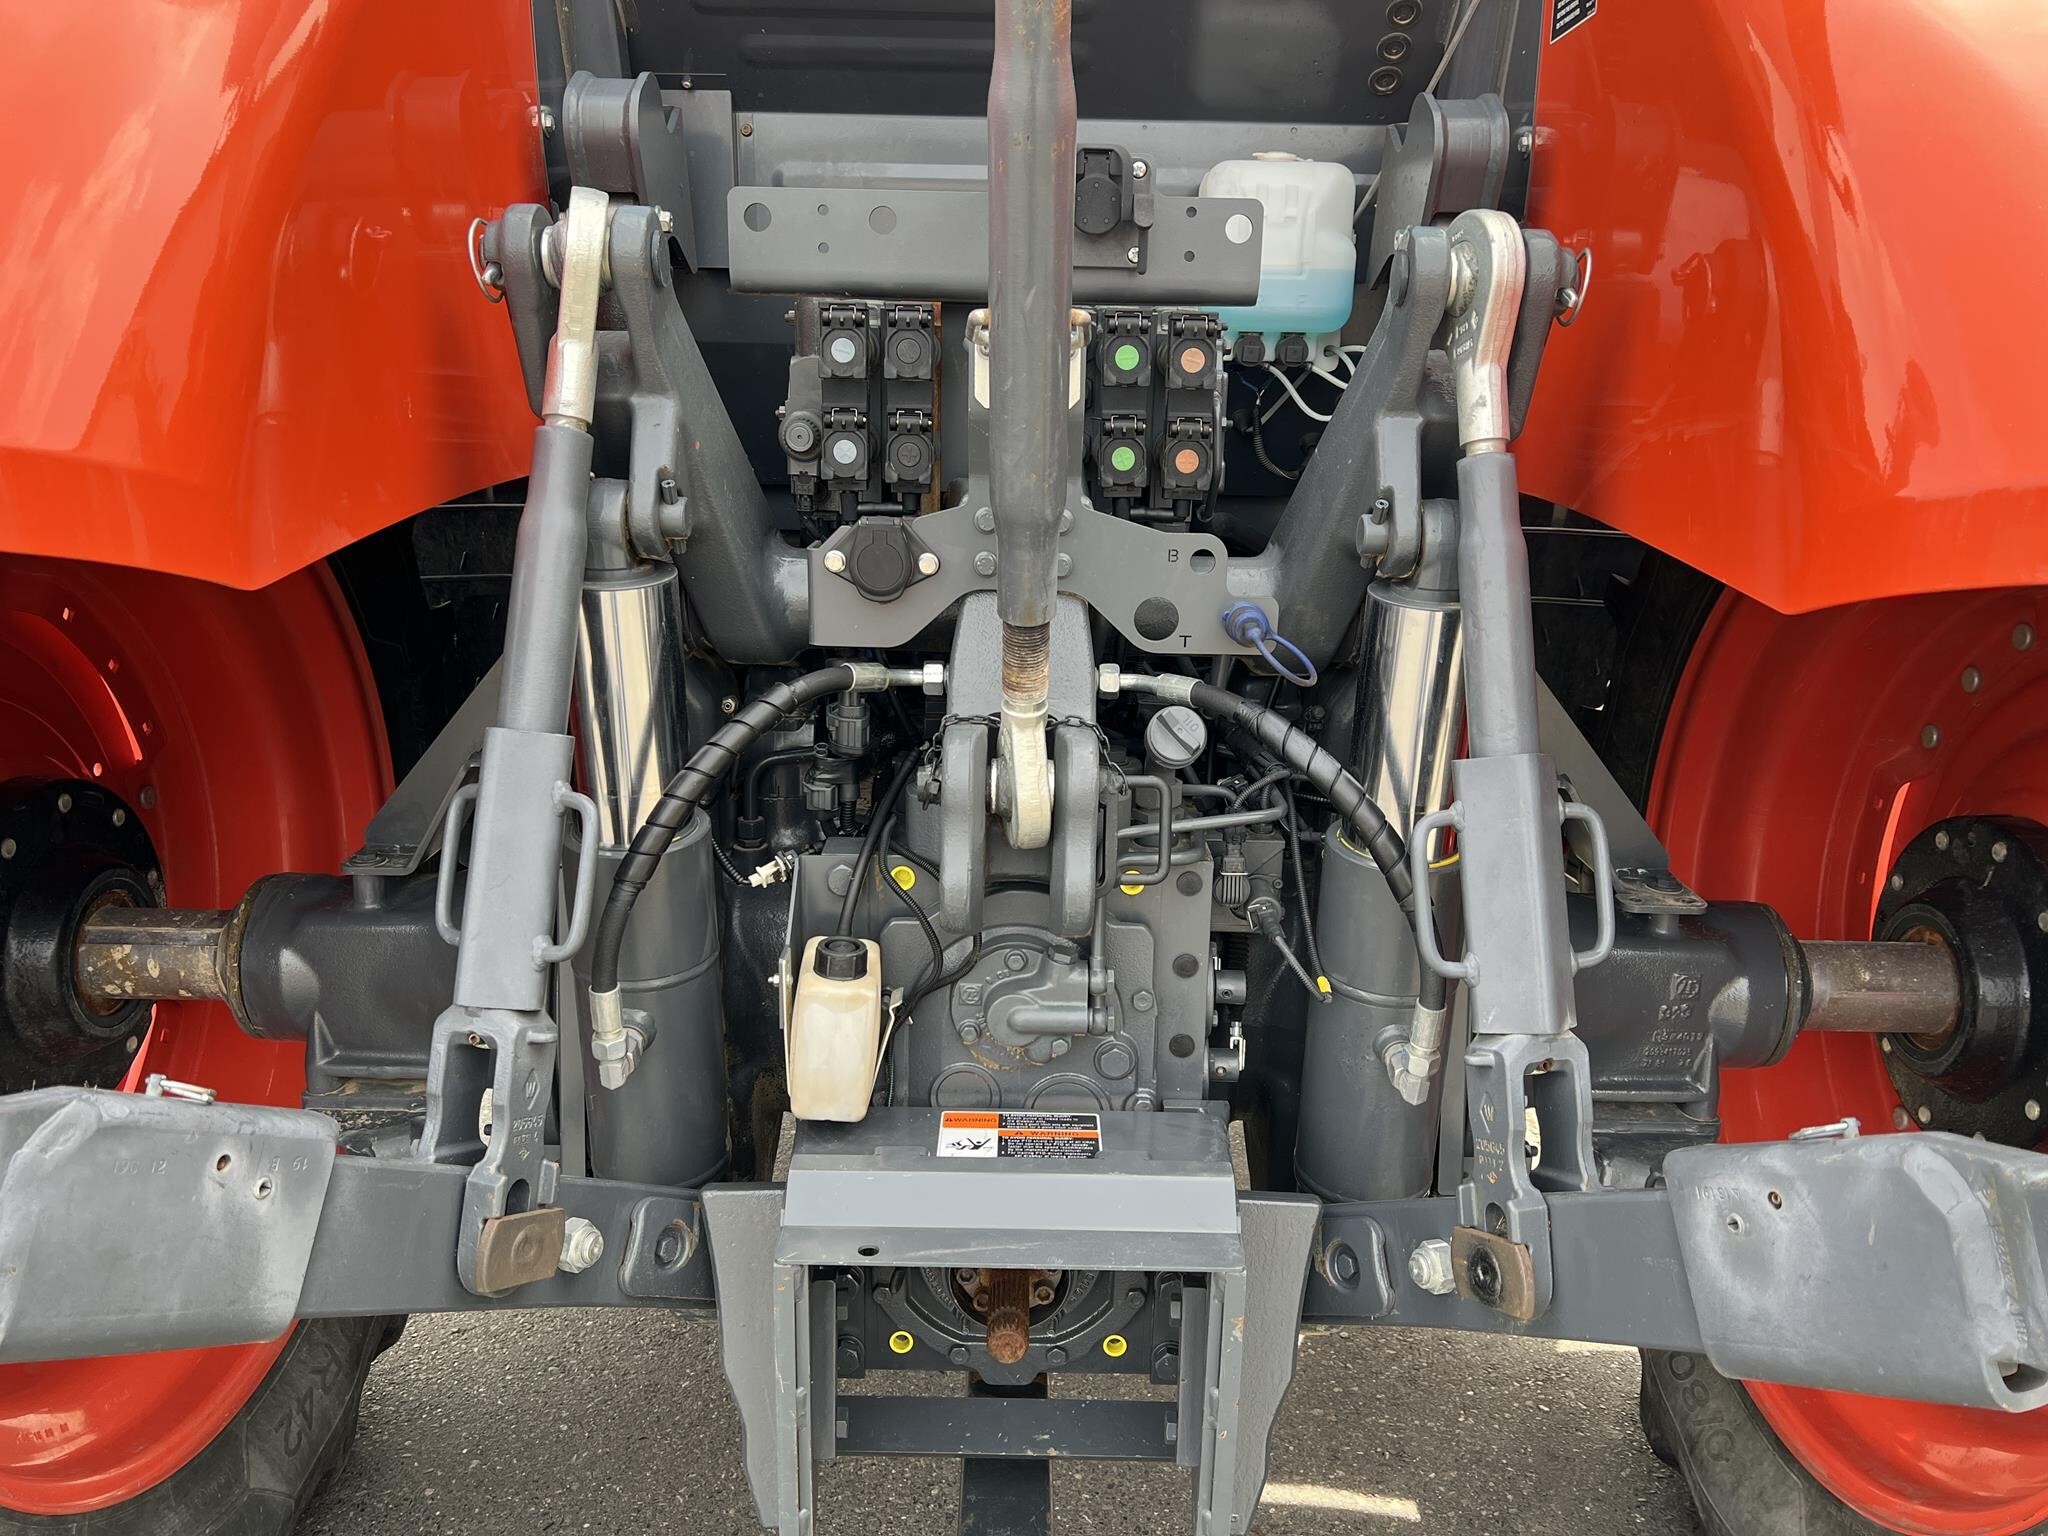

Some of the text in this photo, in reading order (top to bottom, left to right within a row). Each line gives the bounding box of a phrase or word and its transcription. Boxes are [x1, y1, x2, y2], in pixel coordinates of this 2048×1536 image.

[1167, 548, 1180, 563] B
[1178, 634, 1193, 648] T
[1183, 712, 1200, 733] OIL
